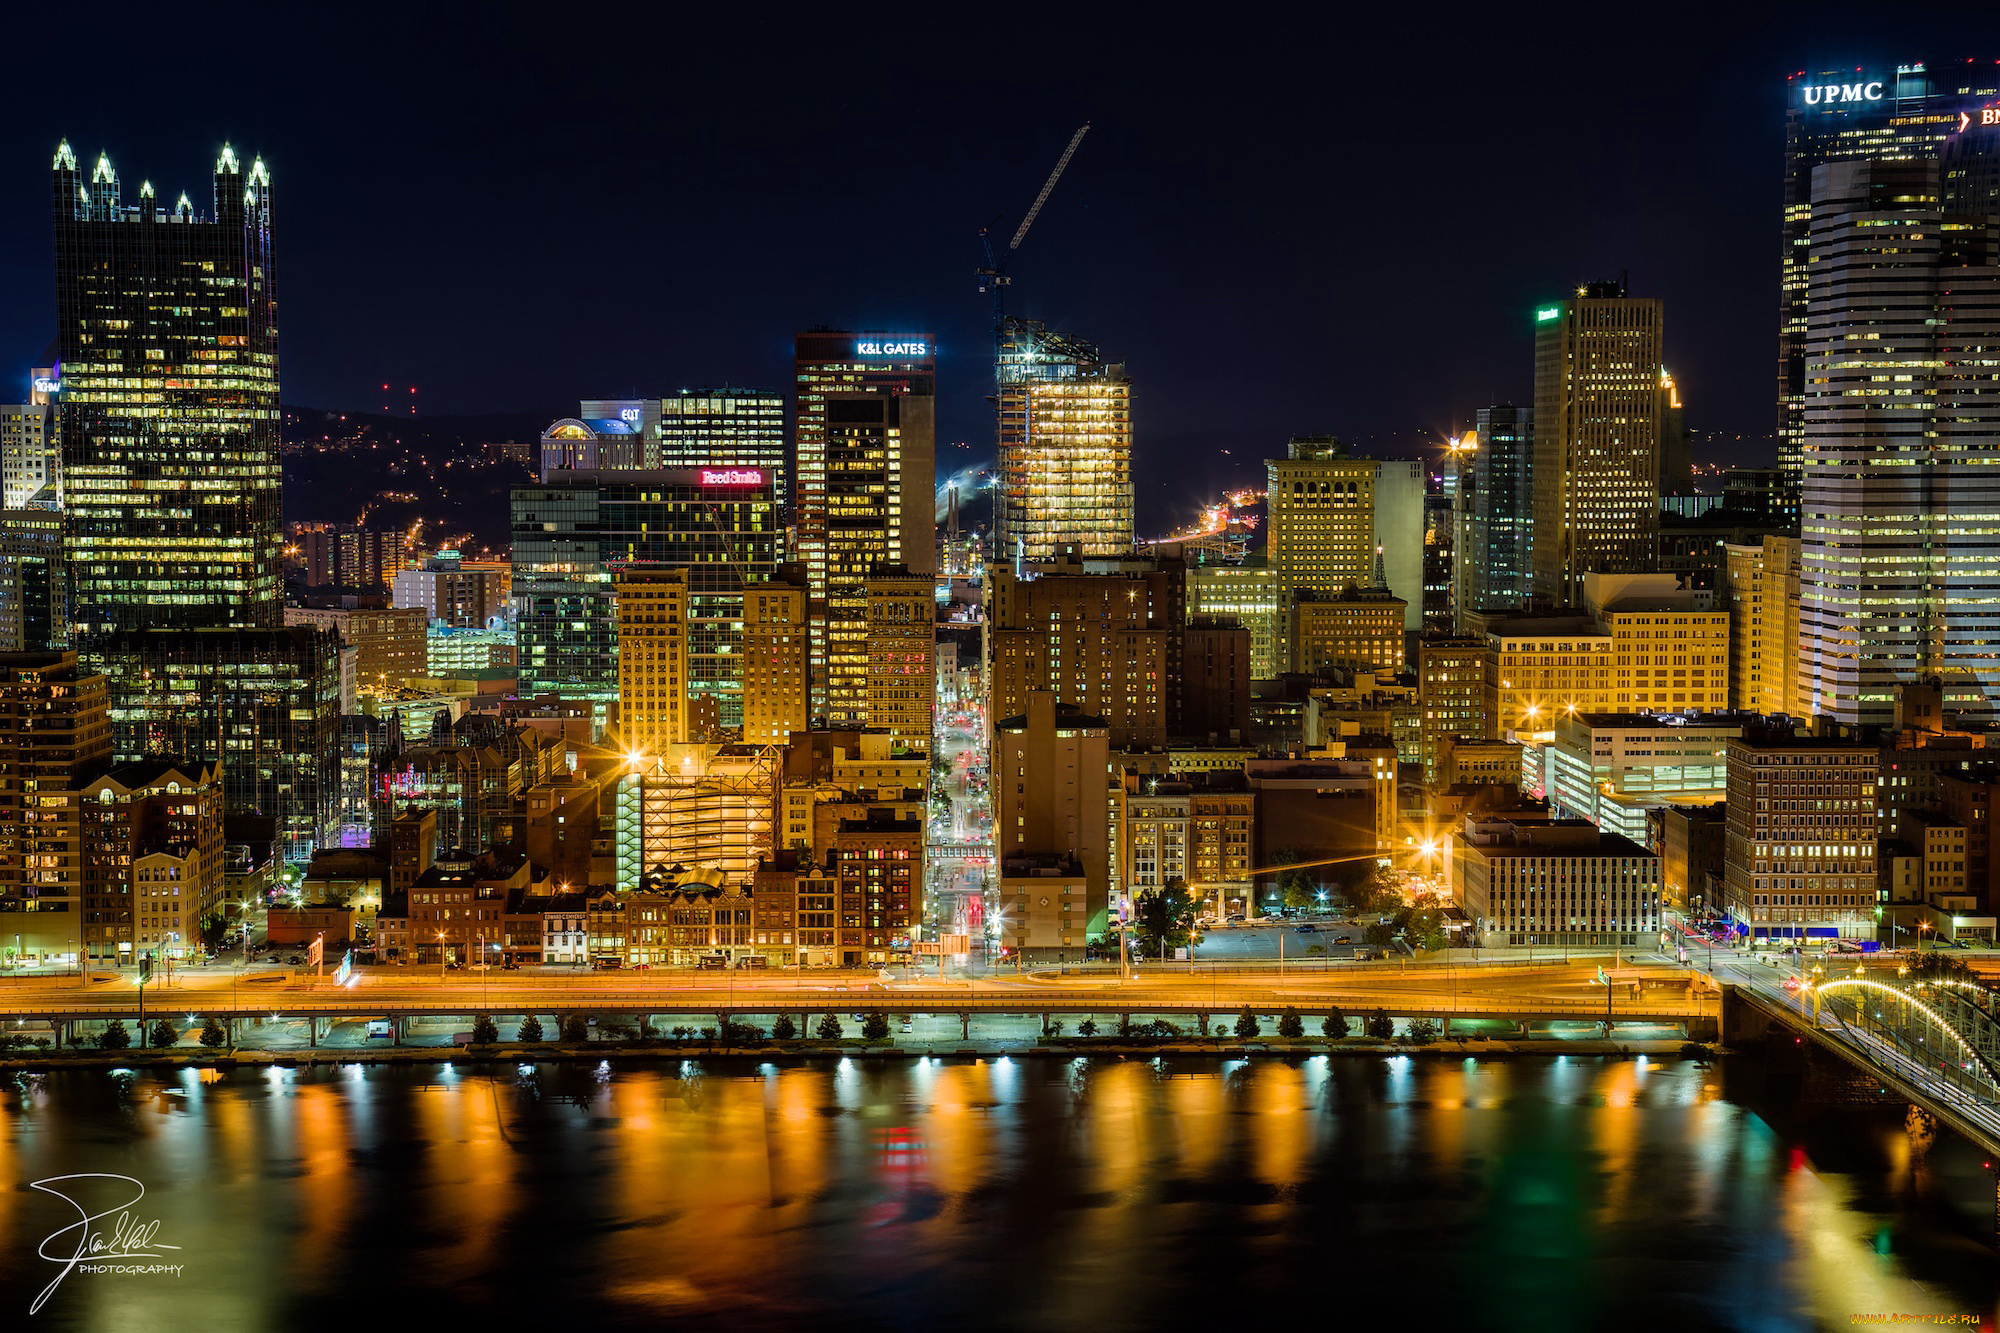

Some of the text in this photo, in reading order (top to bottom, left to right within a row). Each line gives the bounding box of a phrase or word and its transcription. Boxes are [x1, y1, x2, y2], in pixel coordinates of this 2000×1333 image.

[1803, 82, 1883, 105] UPMC
[858, 343, 926, 354] K&L GATES
[621, 408, 640, 421] EQT
[702, 471, 761, 484] Reed Smith
